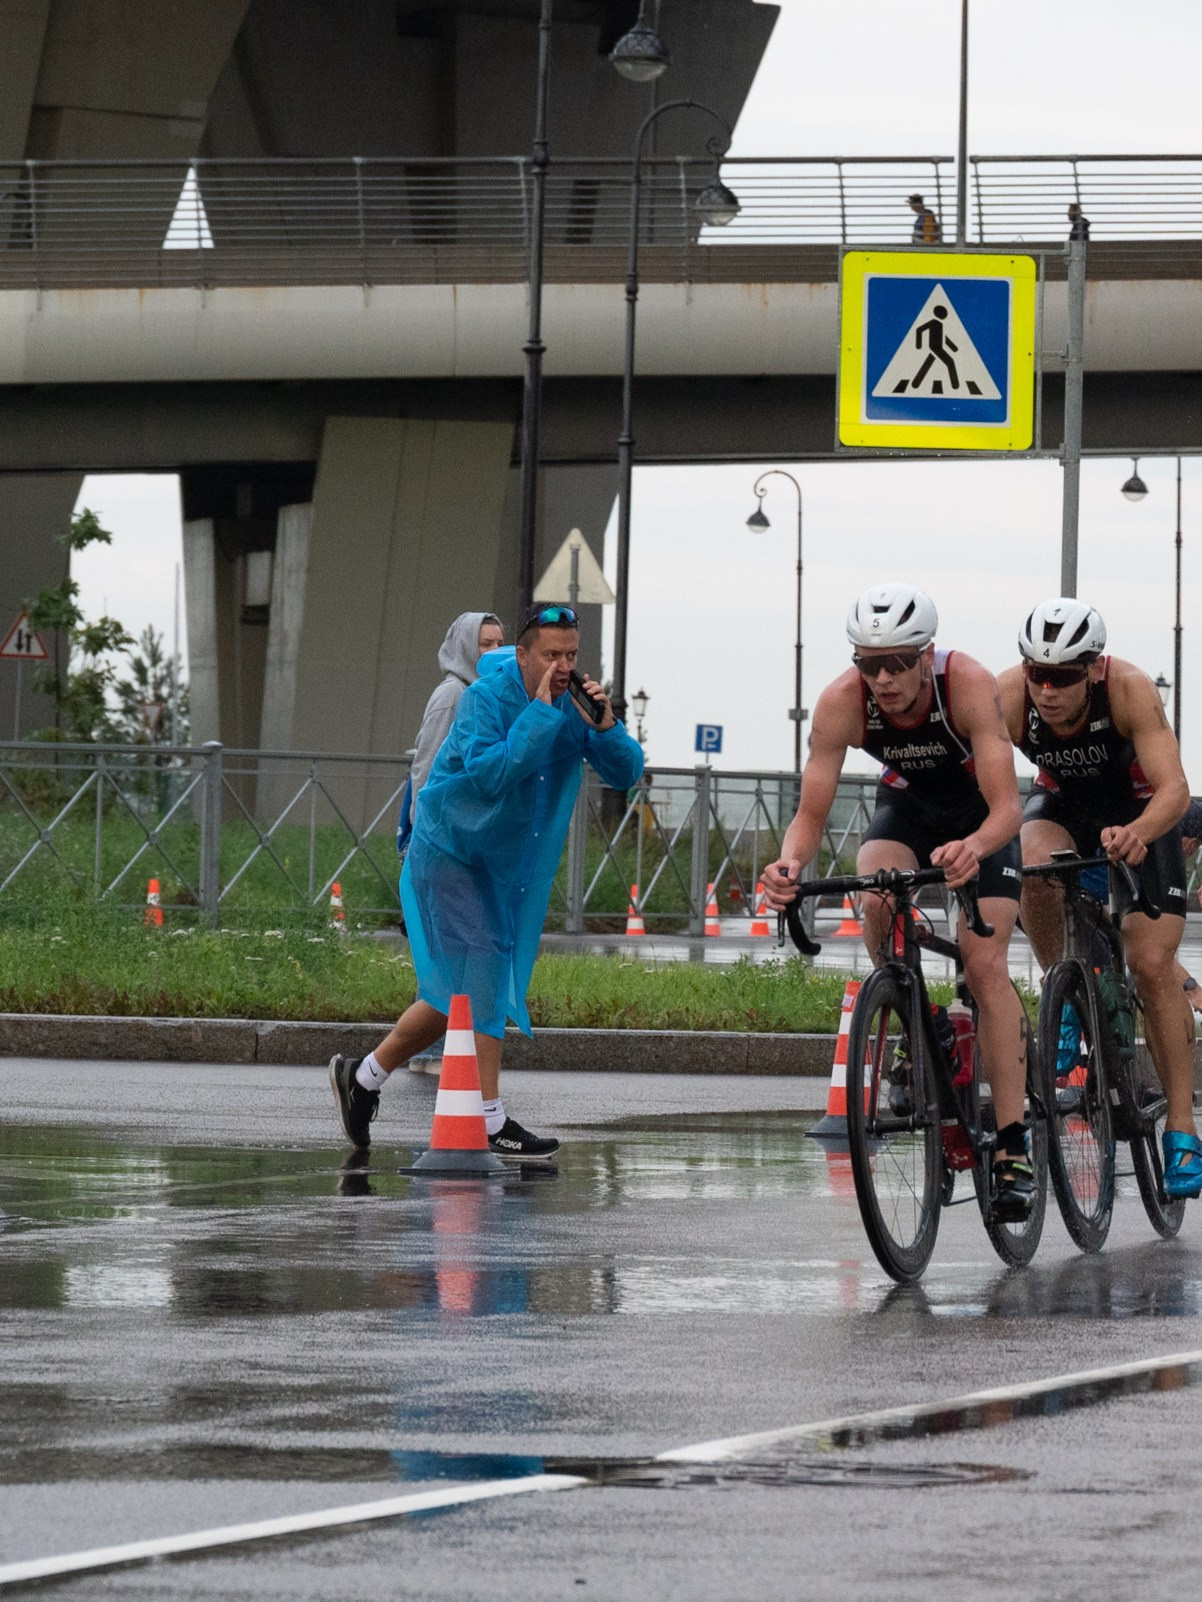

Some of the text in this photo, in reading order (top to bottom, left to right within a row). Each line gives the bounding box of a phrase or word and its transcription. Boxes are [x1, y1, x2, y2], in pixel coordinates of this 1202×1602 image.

[872, 617, 881, 629] 5
[1042, 648, 1051, 659] 4
[883, 741, 948, 760] Krivaltsevich
[900, 759, 936, 770] RUS
[495, 1136, 523, 1150] HOKA
